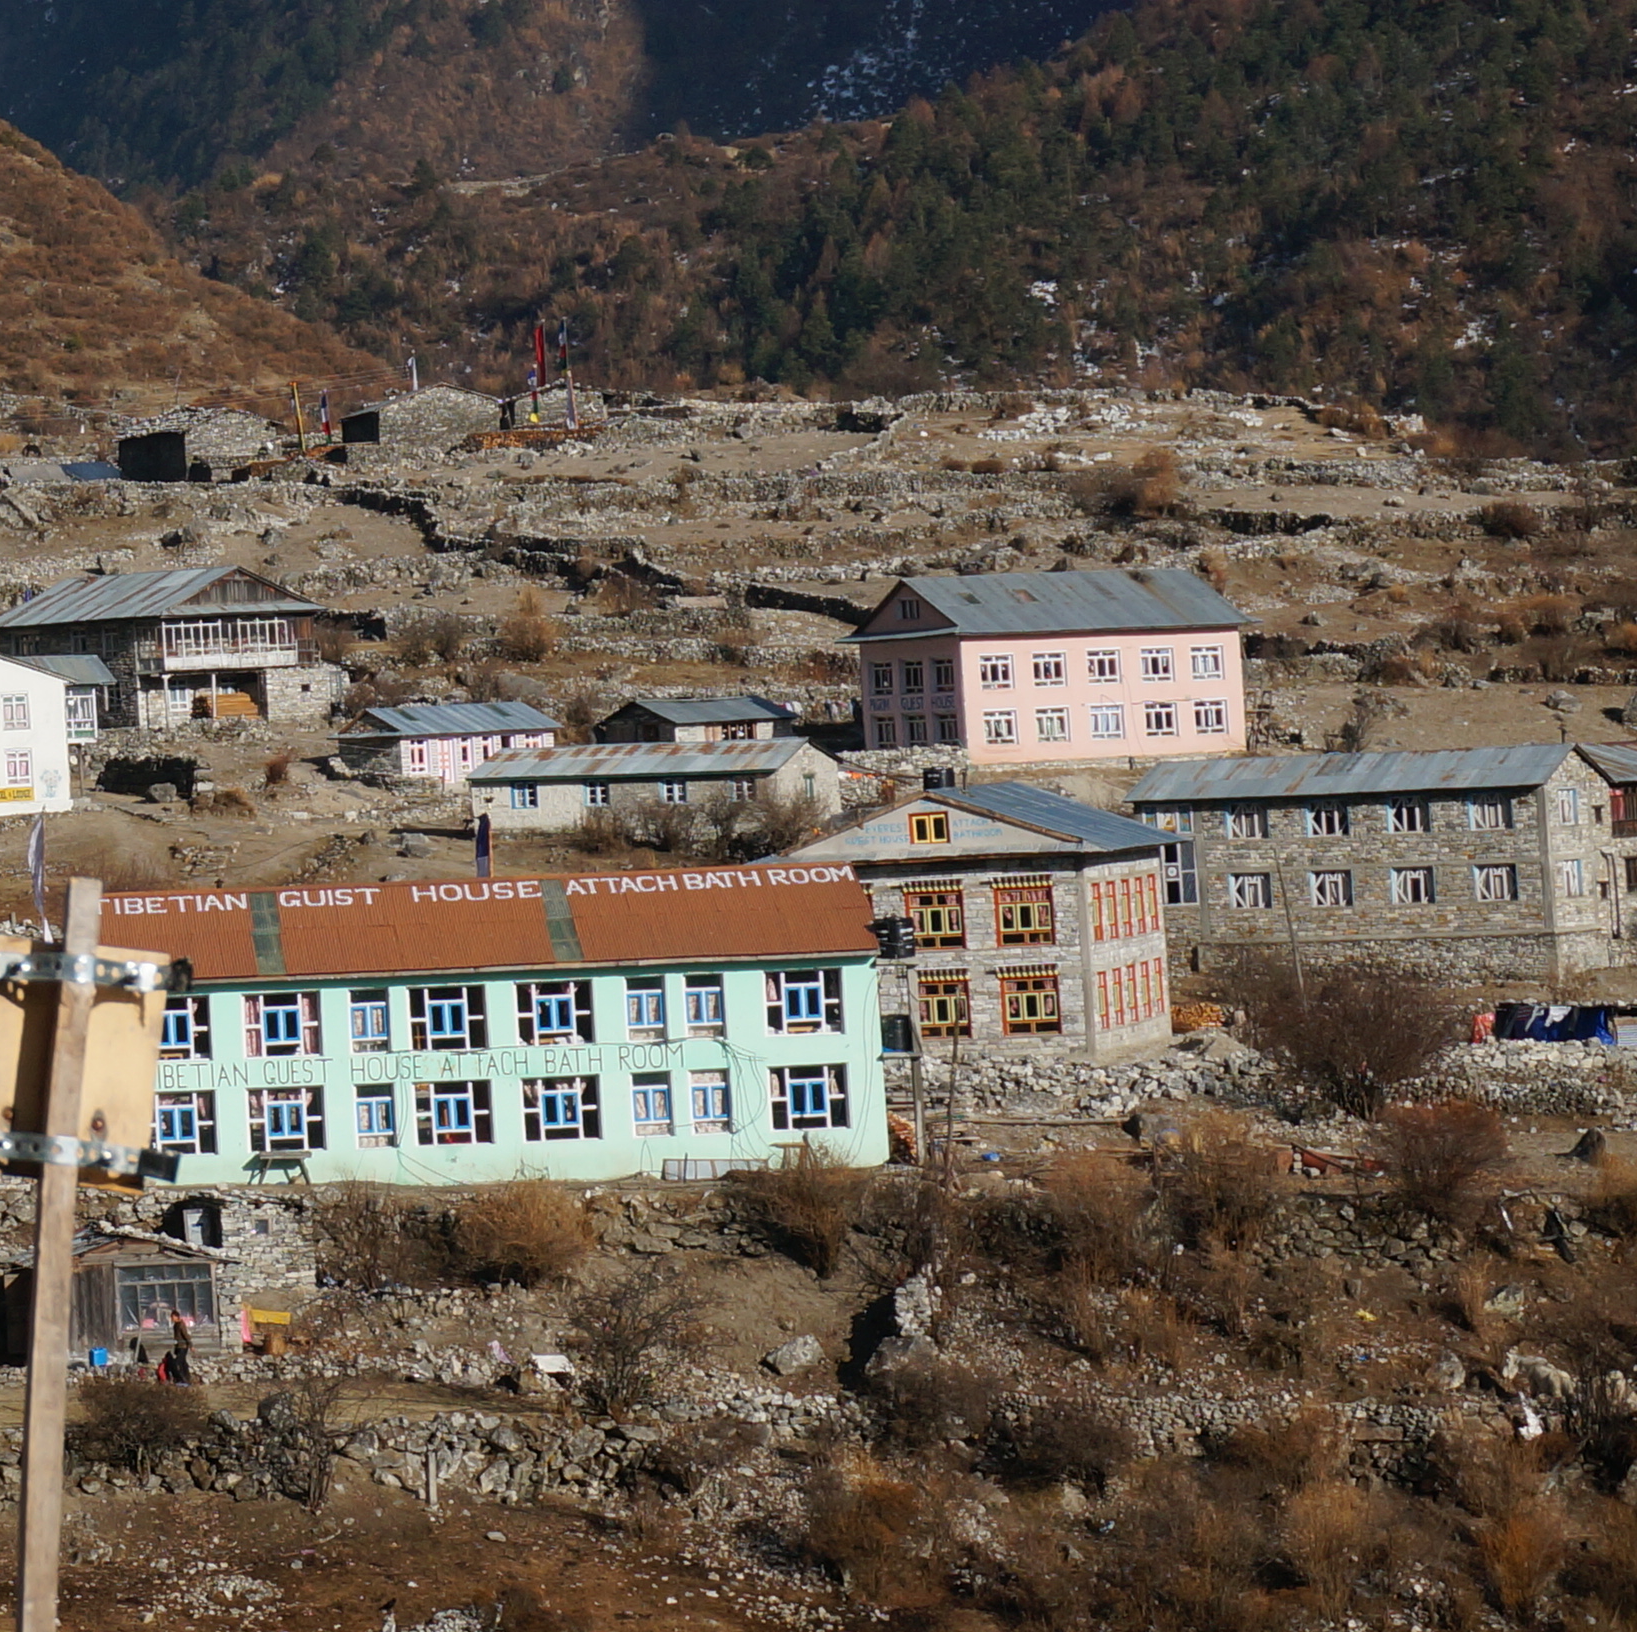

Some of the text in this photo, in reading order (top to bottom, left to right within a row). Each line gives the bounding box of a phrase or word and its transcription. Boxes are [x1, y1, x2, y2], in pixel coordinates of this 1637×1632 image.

[900, 696, 924, 710] GUEST
[931, 694, 956, 709] HOUSE
[865, 822, 908, 834] EVEREST
[845, 834, 910, 845] GUEST HOUSE
[279, 888, 380, 907] GUIST
[411, 880, 543, 902] HOUSE
[565, 874, 677, 896] ATTACH
[682, 870, 762, 891] BATH
[766, 865, 855, 886] ROOM
[157, 1063, 249, 1089] IBETIAN
[263, 1059, 333, 1085] GUEST
[350, 1055, 423, 1082] HOUSE
[544, 1048, 603, 1074] BATH
[619, 1043, 684, 1070] ROOM
